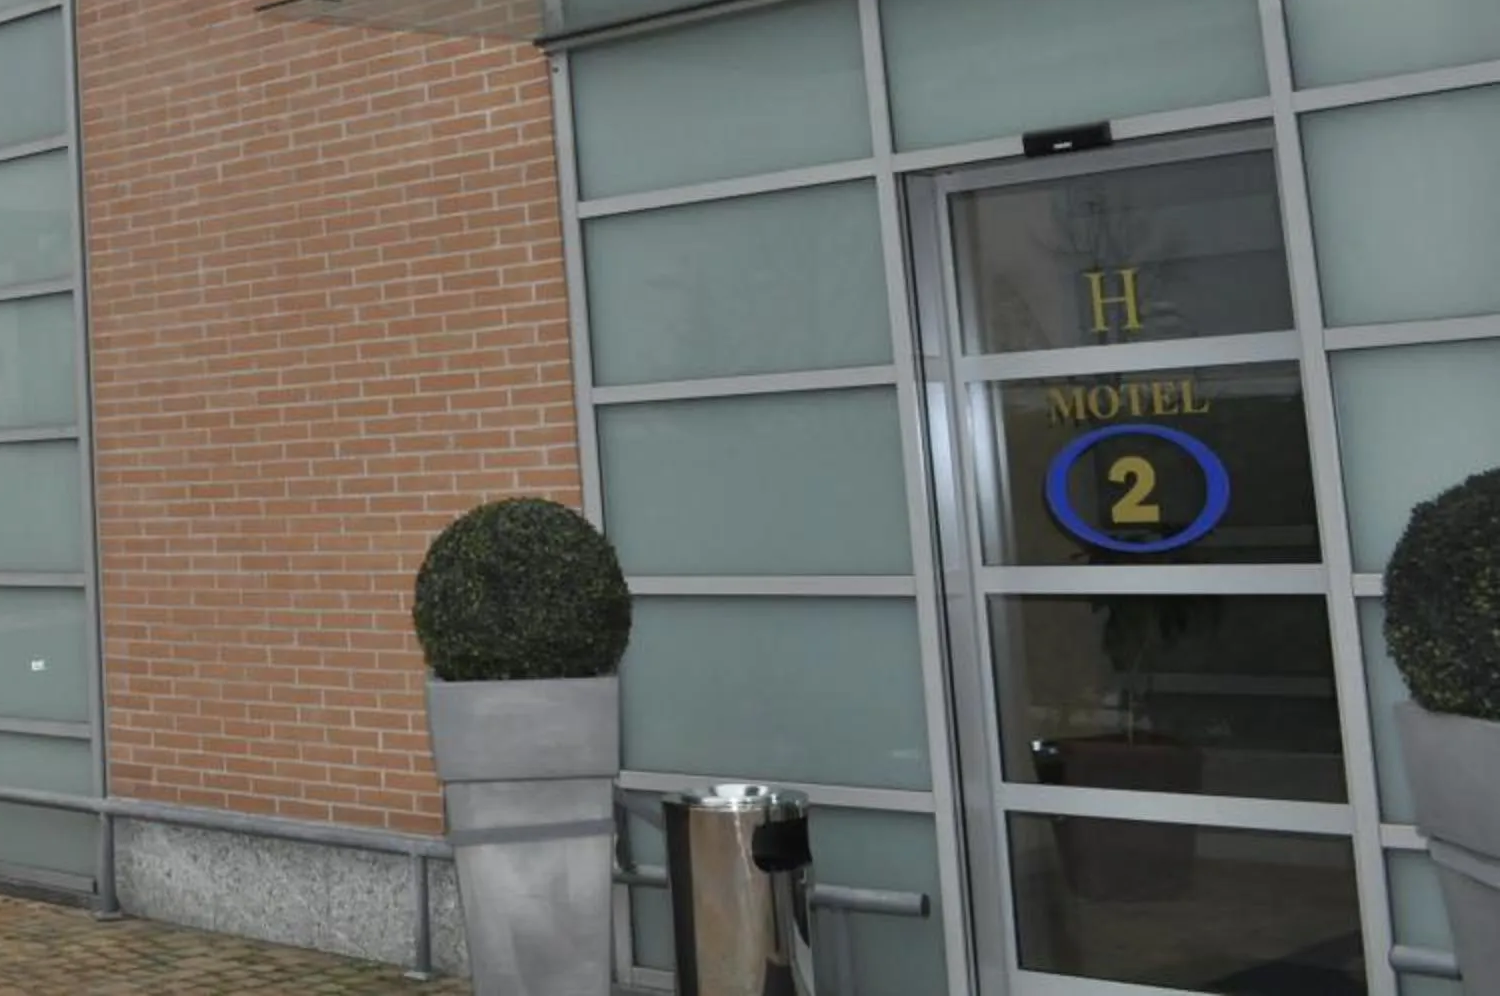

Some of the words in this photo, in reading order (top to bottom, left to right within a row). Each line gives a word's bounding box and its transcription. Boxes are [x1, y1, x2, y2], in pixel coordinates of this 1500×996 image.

[1083, 267, 1144, 332] H
[1049, 378, 1211, 425] MOTEL
[1108, 456, 1160, 523] 2
